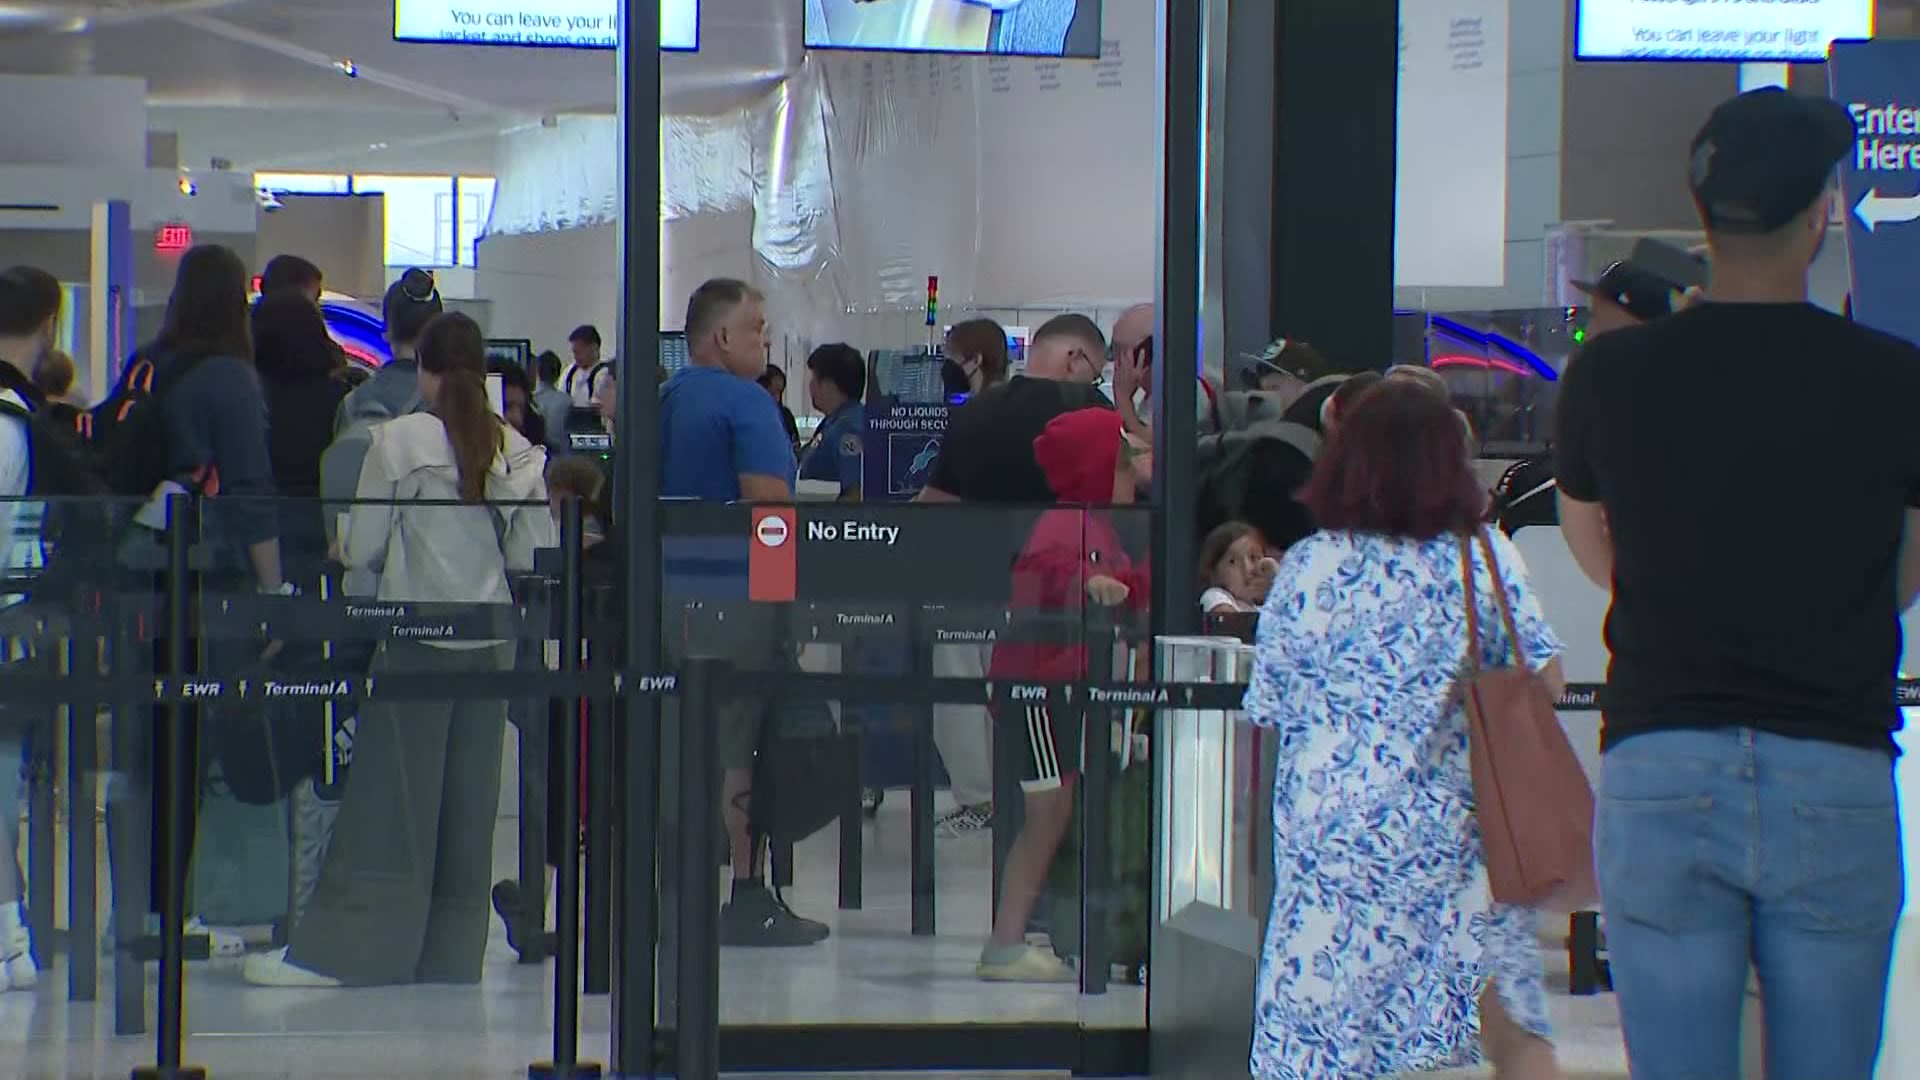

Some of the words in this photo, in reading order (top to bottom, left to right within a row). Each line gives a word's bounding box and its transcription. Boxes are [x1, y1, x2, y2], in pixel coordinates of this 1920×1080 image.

[452, 10, 481, 25] You
[486, 13, 513, 26] can
[519, 12, 561, 27] leave
[566, 15, 601, 31] your
[1633, 27, 1662, 41] You
[1666, 29, 1692, 41] can
[1698, 28, 1739, 42] leave
[1744, 31, 1780, 46] your
[1785, 29, 1818, 45] light
[1857, 139, 1920, 169] Here
[891, 407, 906, 416] NO
[908, 407, 948, 416] LIQUIDS
[870, 419, 918, 429] THROUGH
[807, 522, 837, 540] No
[843, 522, 899, 544] Entry
[346, 606, 395, 616] Terminal
[836, 614, 885, 624] Terminal
[392, 626, 443, 636] Terminal
[936, 630, 987, 640] Terminal
[182, 684, 220, 696] EWR
[264, 682, 334, 696] Terminal
[335, 682, 349, 695] A
[640, 677, 676, 690] EWR
[1011, 686, 1047, 699] EWR
[1089, 688, 1157, 702] Terminal
[1157, 689, 1169, 702] A
[1896, 686, 1920, 699] EW
